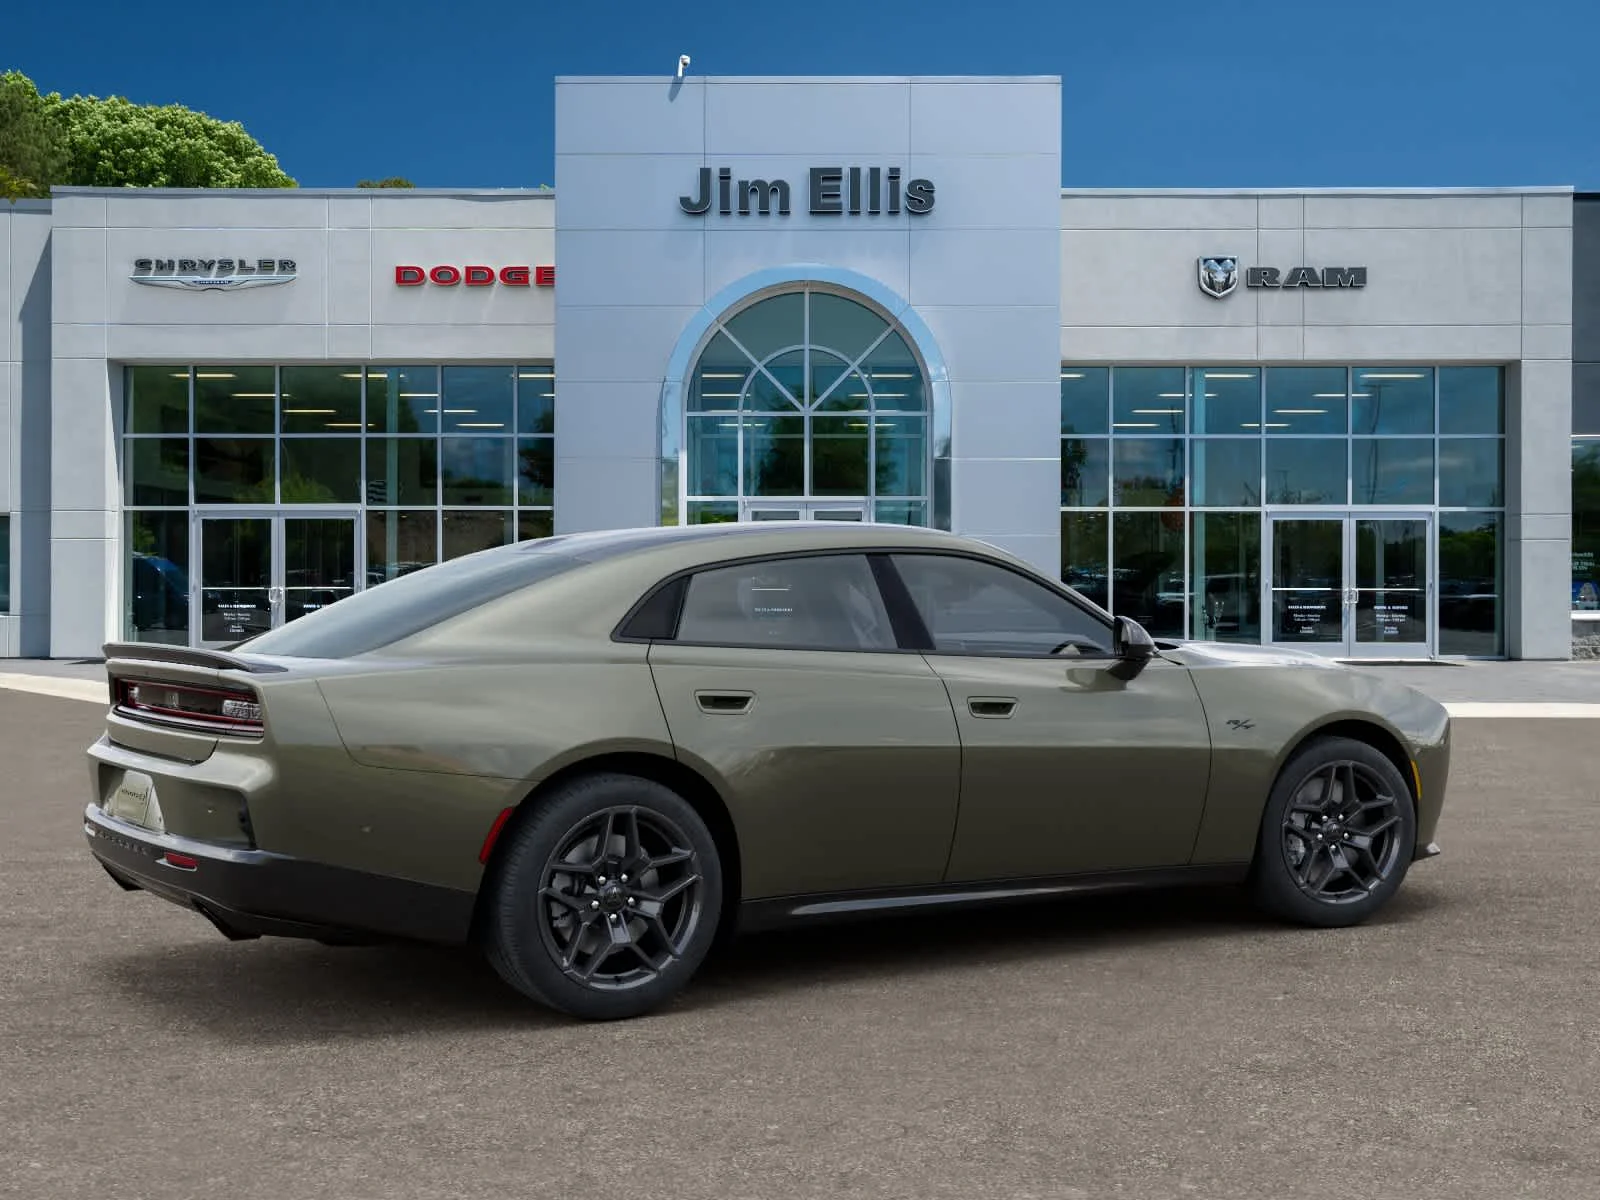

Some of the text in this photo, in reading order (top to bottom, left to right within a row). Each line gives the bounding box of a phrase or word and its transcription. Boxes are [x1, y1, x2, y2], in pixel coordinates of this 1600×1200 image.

[679, 167, 936, 214] Jim Ellis
[134, 258, 297, 272] CHRYSLER
[395, 265, 555, 287] DODGE
[1247, 267, 1367, 288] RAM
